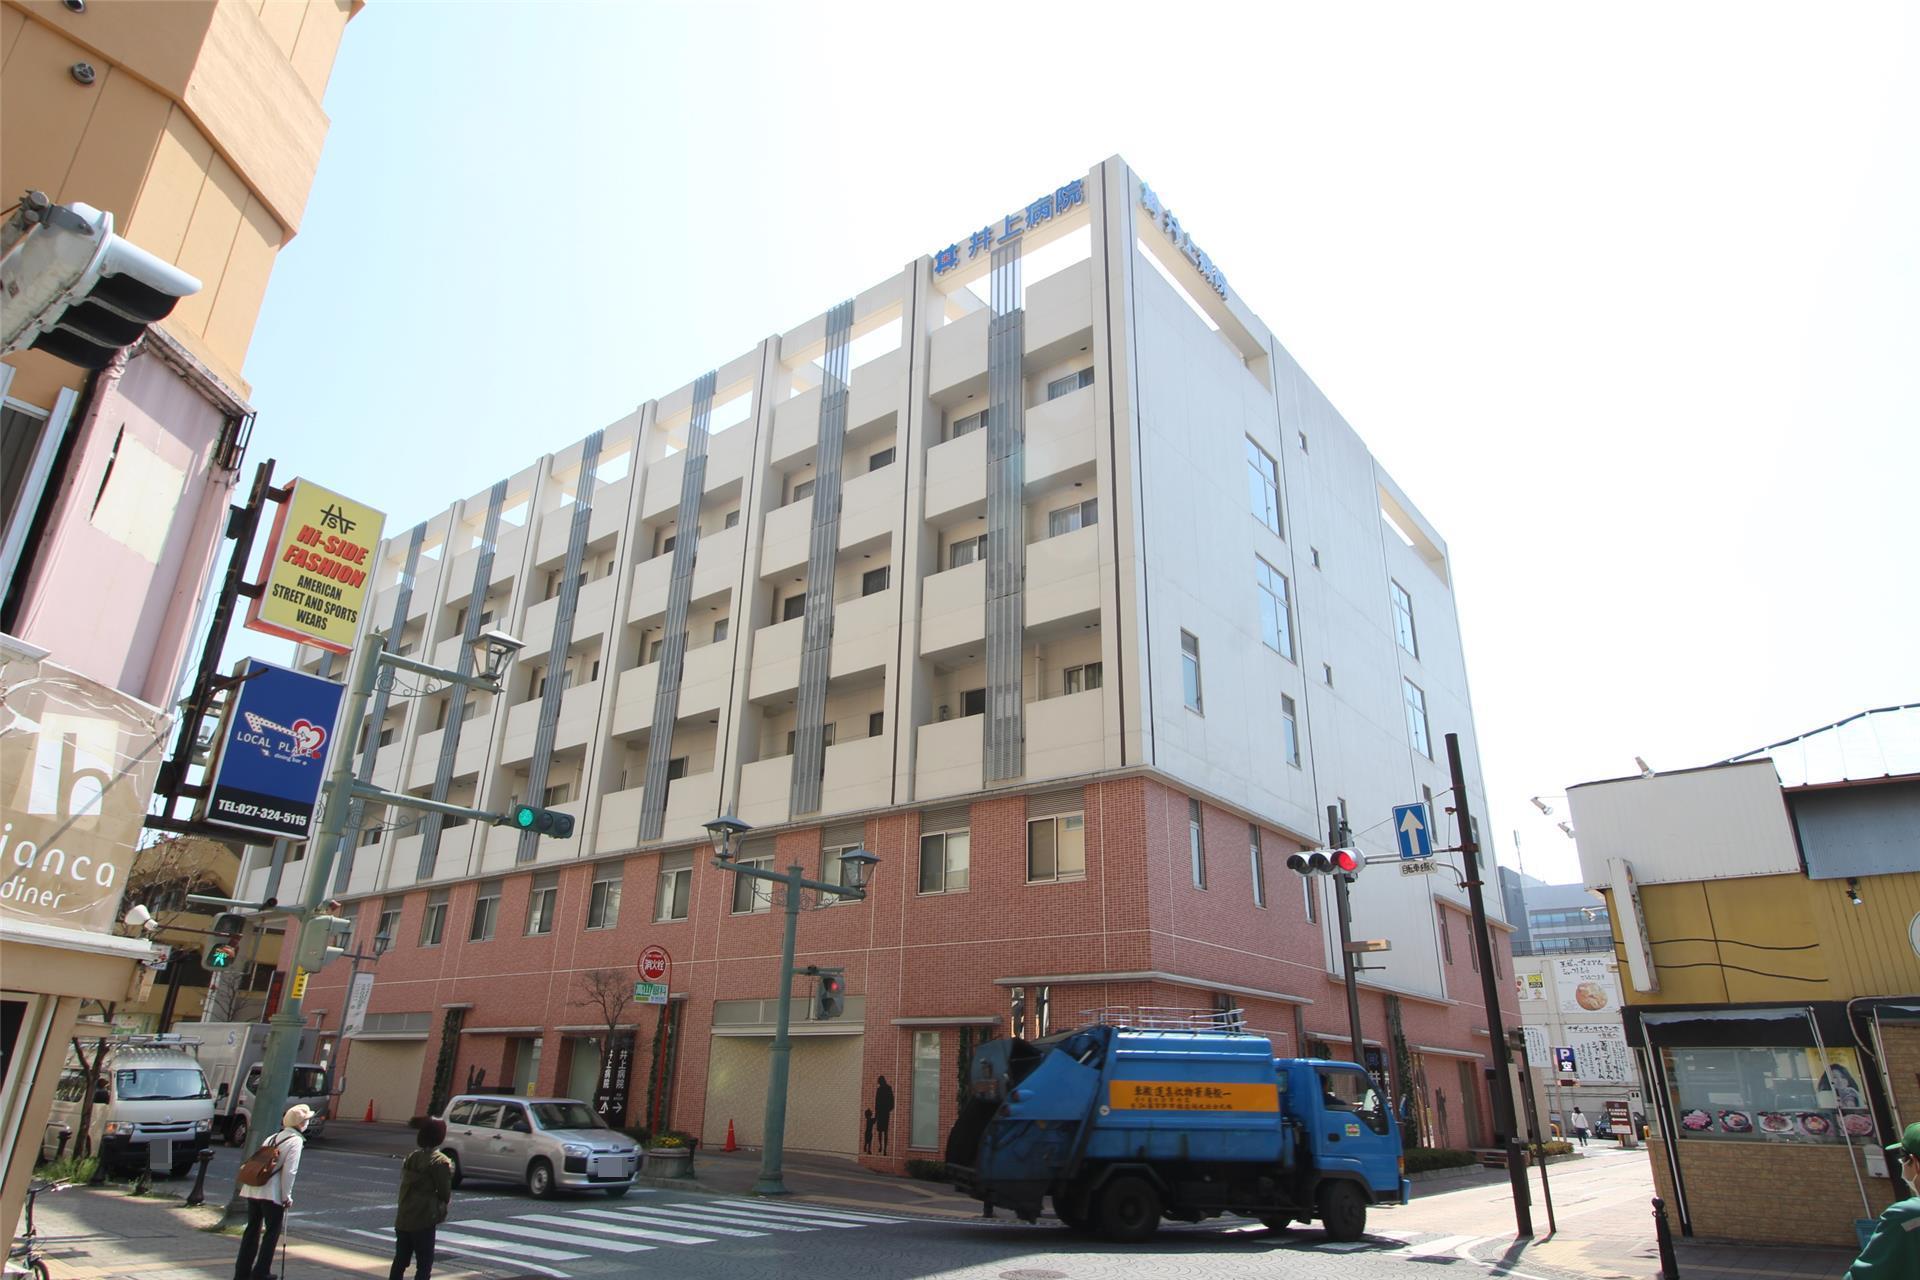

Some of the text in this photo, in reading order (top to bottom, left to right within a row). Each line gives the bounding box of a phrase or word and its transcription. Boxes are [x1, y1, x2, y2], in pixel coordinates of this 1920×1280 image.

[282, 544, 367, 589] FASHION
[297, 575, 343, 601] AMERICAN
[272, 583, 358, 623] STREET AND SPORTS
[296, 609, 328, 630] WEARS
[236, 731, 313, 758] LOCAL PLACE
[218, 799, 308, 826] TEL:027-324-5115
[0, 875, 67, 909] diner
[644, 959, 664, 971] 消火栓
[1560, 1049, 1570, 1060] P
[1561, 1061, 1573, 1071] 空
